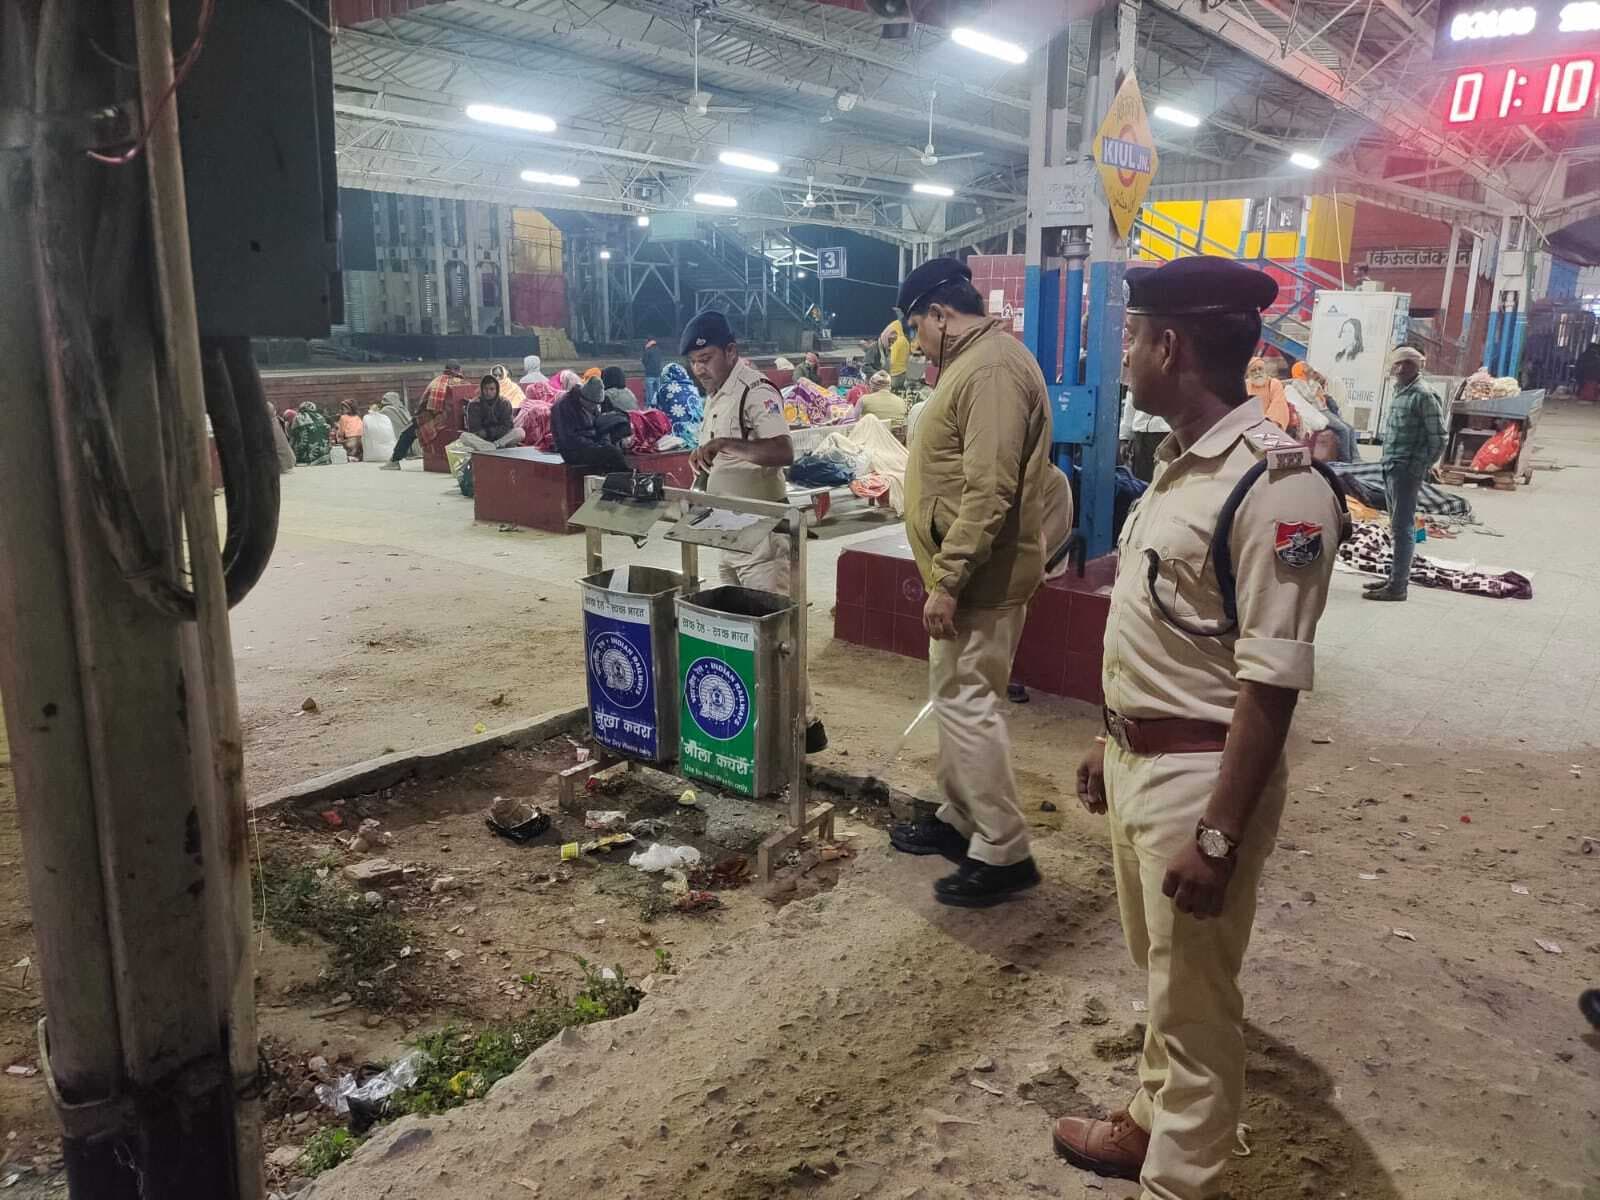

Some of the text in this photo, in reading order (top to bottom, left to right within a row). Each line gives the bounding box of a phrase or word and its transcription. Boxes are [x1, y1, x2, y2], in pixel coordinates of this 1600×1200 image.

[1449, 60, 1594, 123] 01:10
[1103, 138, 1136, 169] KIUL
[824, 251, 836, 269] 3
[710, 661, 745, 727] INDIAN RAILWAYS
